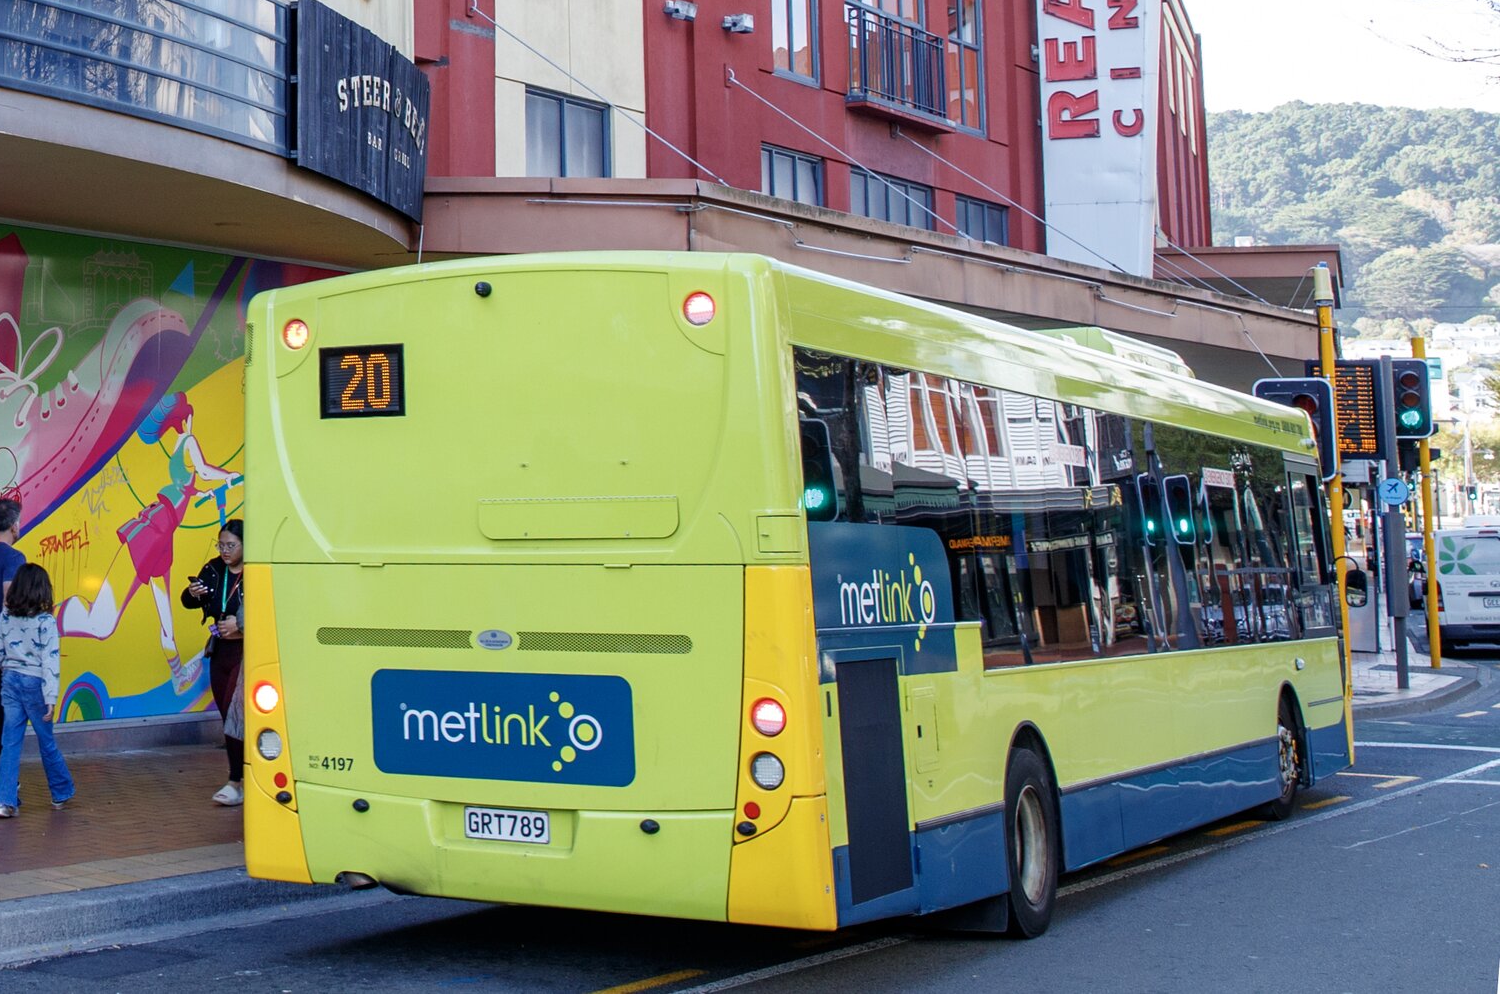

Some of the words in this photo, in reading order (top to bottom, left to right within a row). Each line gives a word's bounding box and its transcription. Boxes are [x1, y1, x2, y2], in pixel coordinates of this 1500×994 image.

[337, 75, 391, 113] STEER
[367, 131, 383, 151] BAR
[341, 352, 391, 410] 20
[840, 568, 915, 625] metlink
[401, 701, 552, 747] metlink
[321, 756, 354, 772] 4197
[468, 811, 546, 839] GRT789
